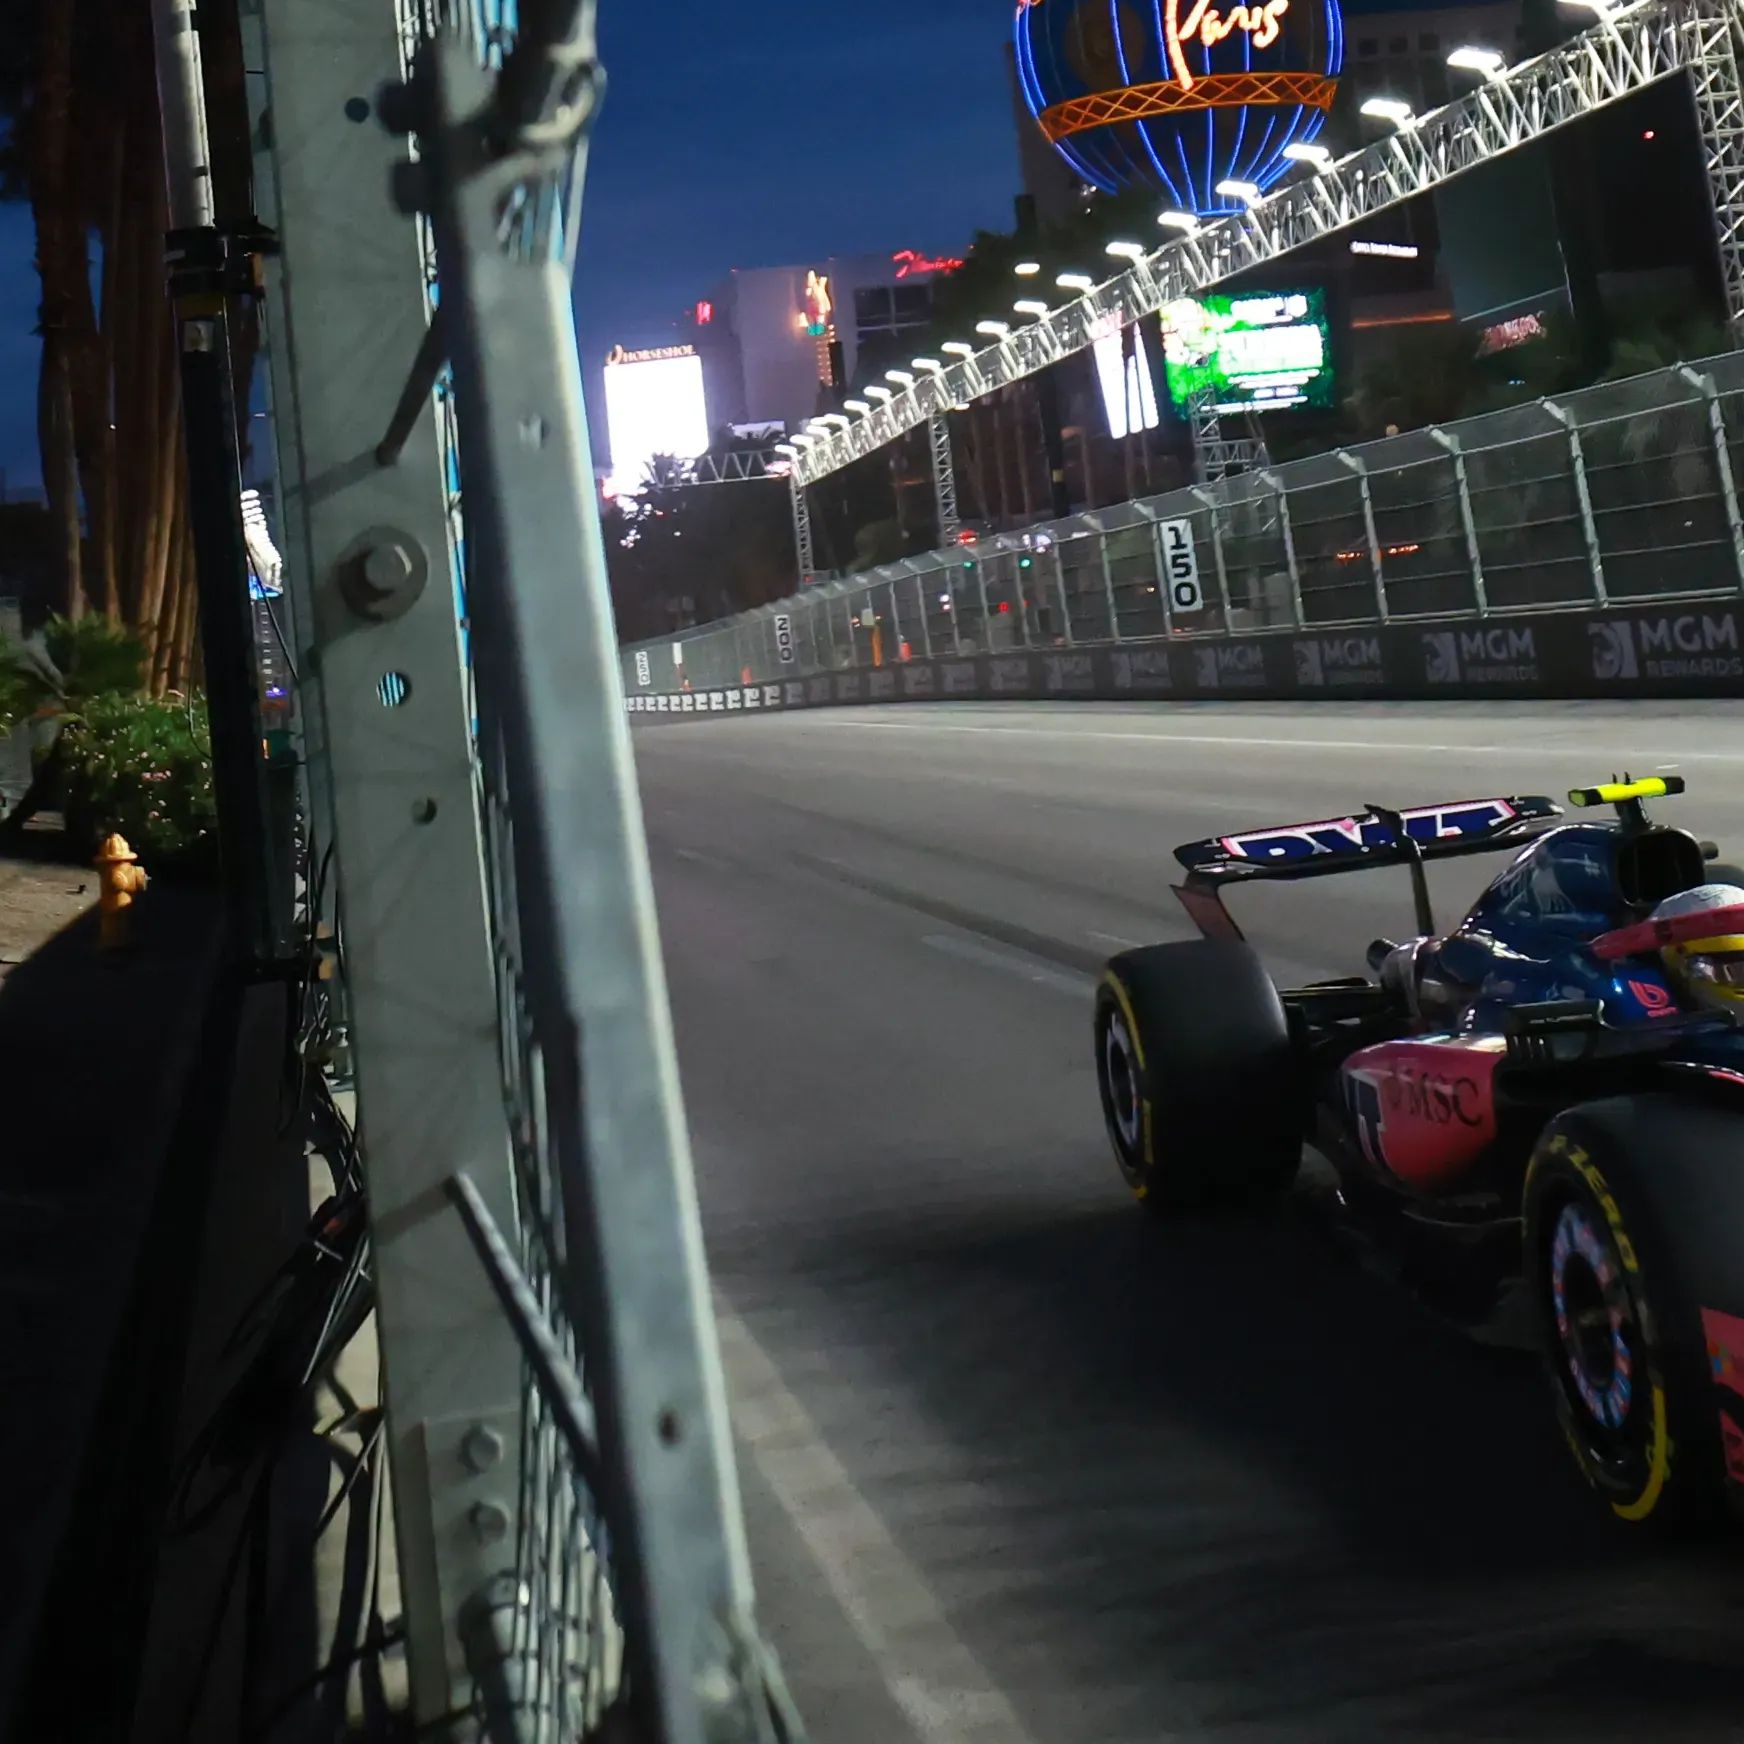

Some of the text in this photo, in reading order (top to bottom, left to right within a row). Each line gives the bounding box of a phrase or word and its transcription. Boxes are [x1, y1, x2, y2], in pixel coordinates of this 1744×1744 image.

[622, 344, 695, 363] HORSESHOE
[1167, 525, 1198, 607] 150
[777, 616, 794, 662] 200
[1459, 626, 1537, 661] MGM
[1639, 612, 1738, 653] MGM
[1644, 656, 1744, 679] REWARDS
